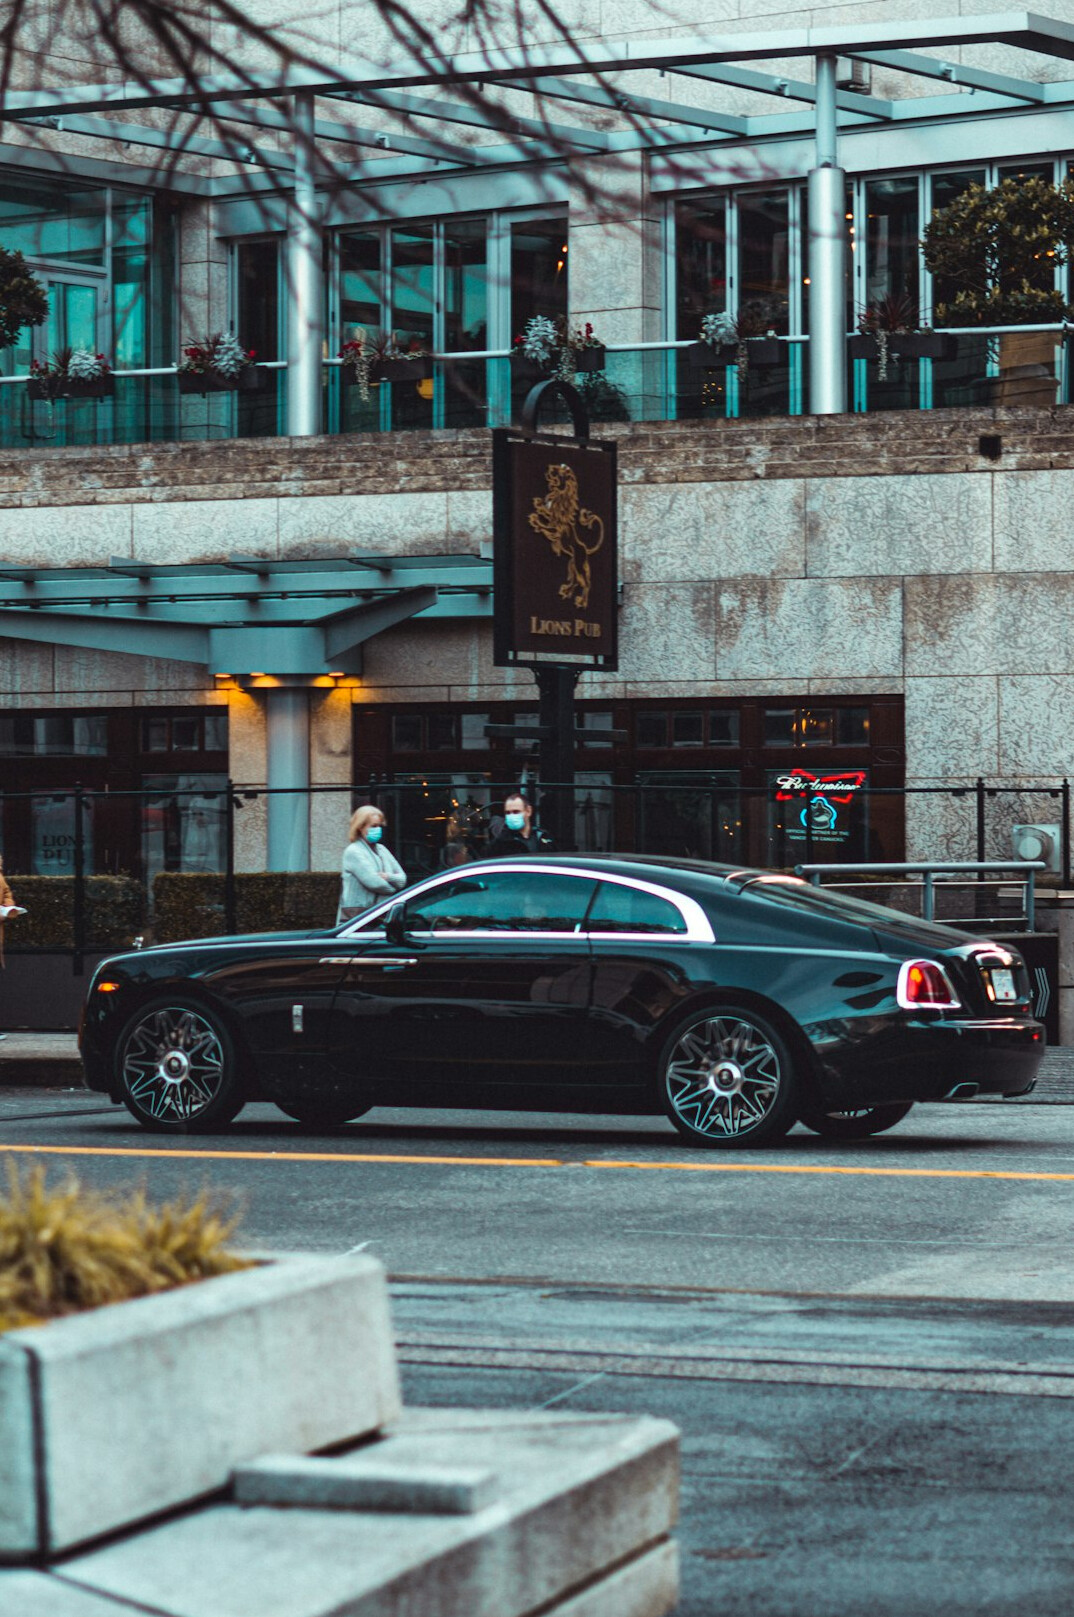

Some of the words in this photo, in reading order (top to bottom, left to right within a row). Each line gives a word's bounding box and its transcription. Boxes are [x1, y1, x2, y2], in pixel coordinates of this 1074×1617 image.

[530, 616, 572, 636] LIONS
[574, 619, 601, 638] PUB
[42, 849, 85, 866] PU
